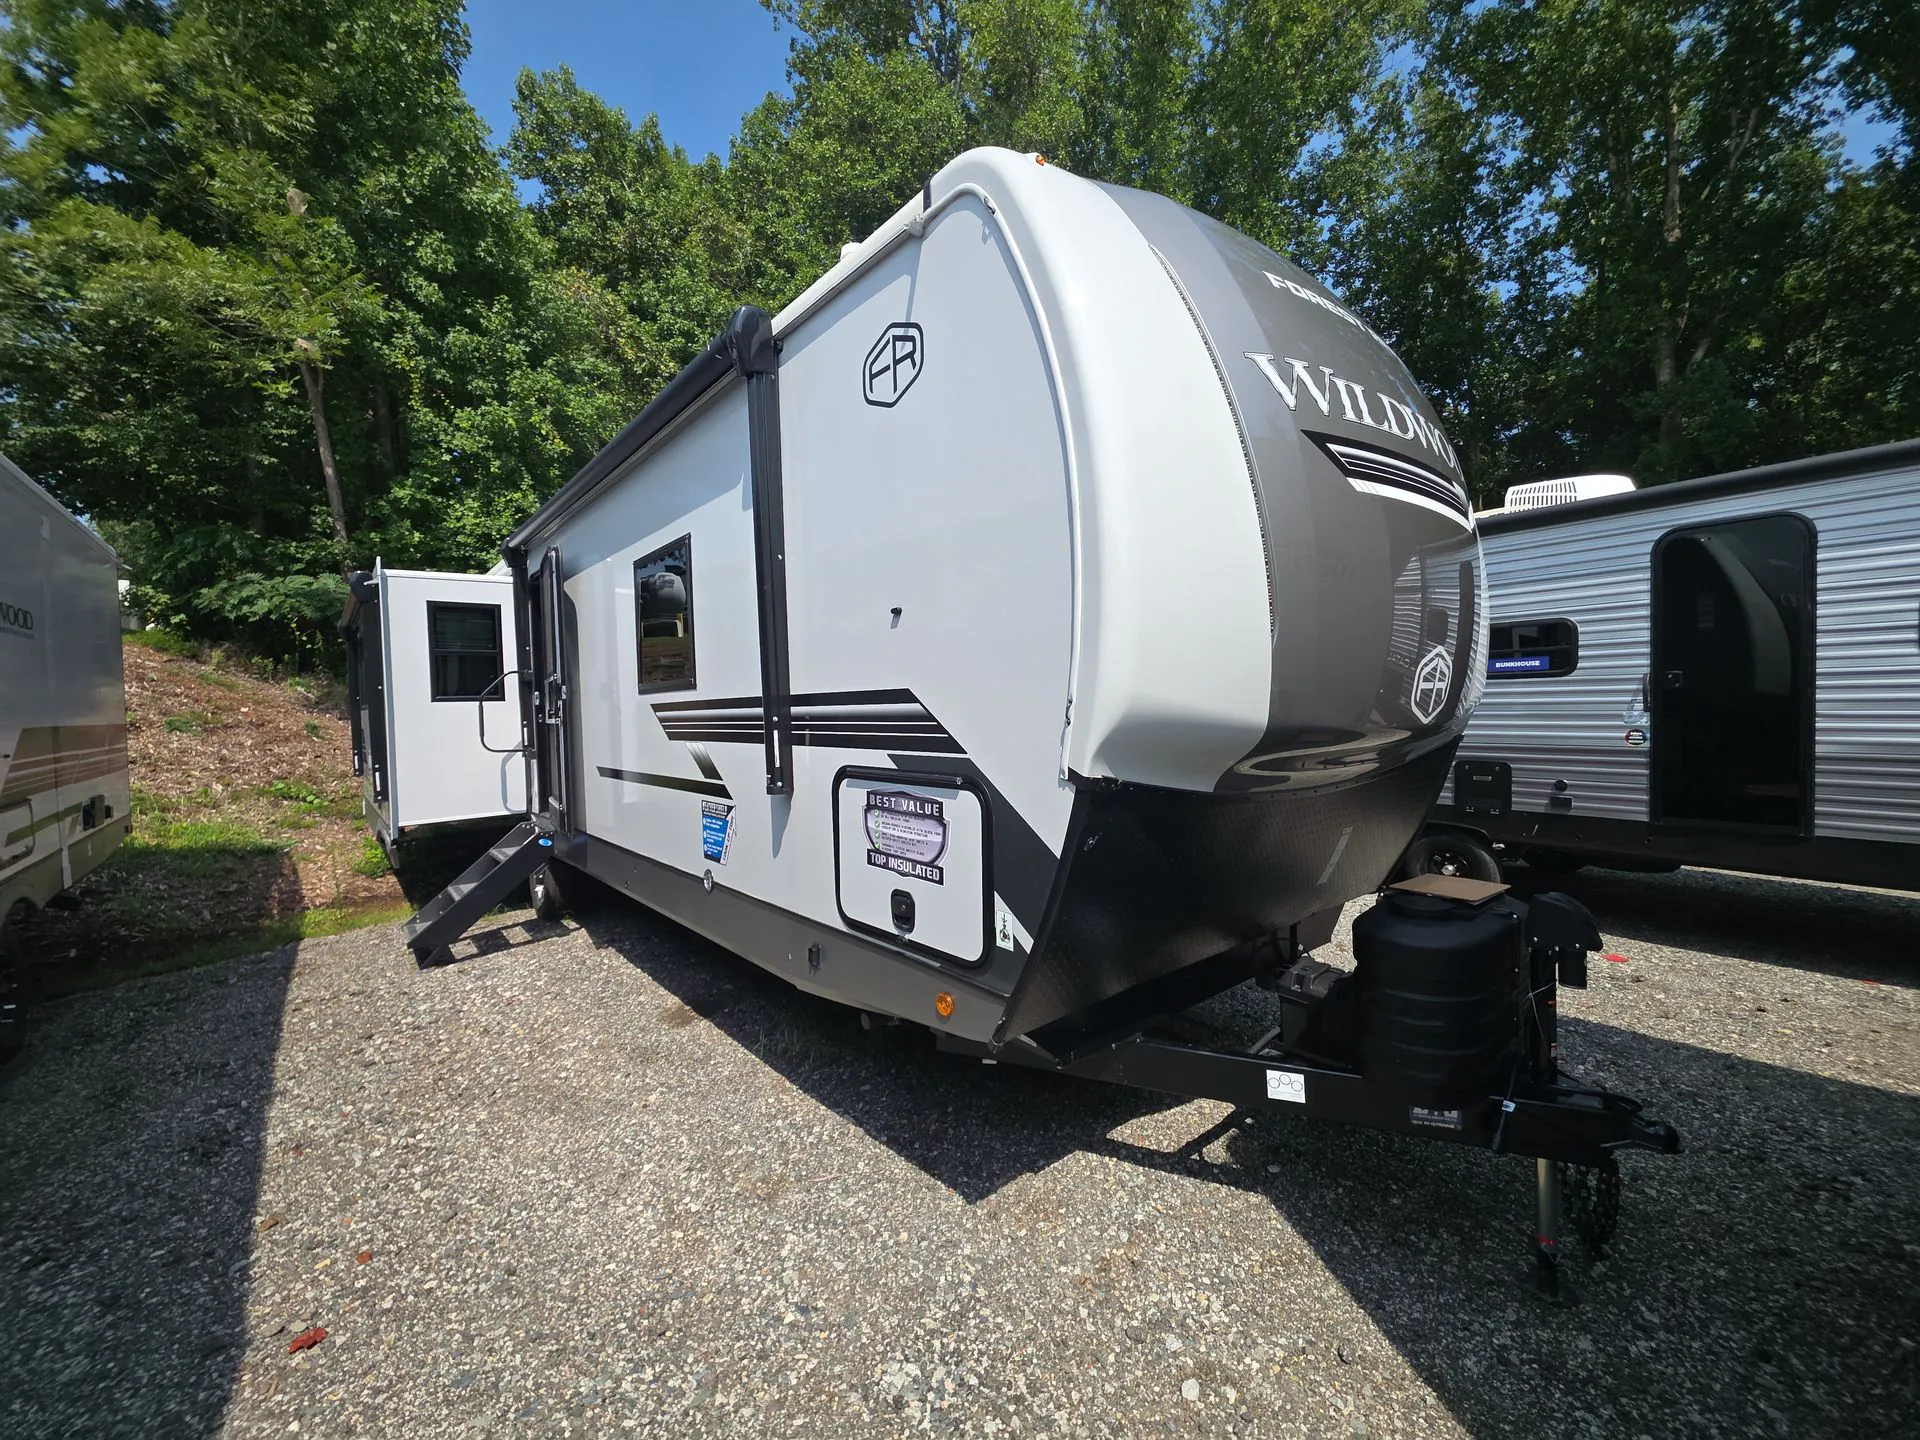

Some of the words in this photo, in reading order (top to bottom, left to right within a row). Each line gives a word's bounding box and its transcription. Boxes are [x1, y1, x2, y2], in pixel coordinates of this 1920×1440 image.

[1495, 660, 1541, 669] BUNKHOUSE
[869, 794, 896, 809] BEST
[901, 799, 940, 817] VALUE
[869, 852, 887, 867] TOP
[888, 856, 940, 881] INSULATED
